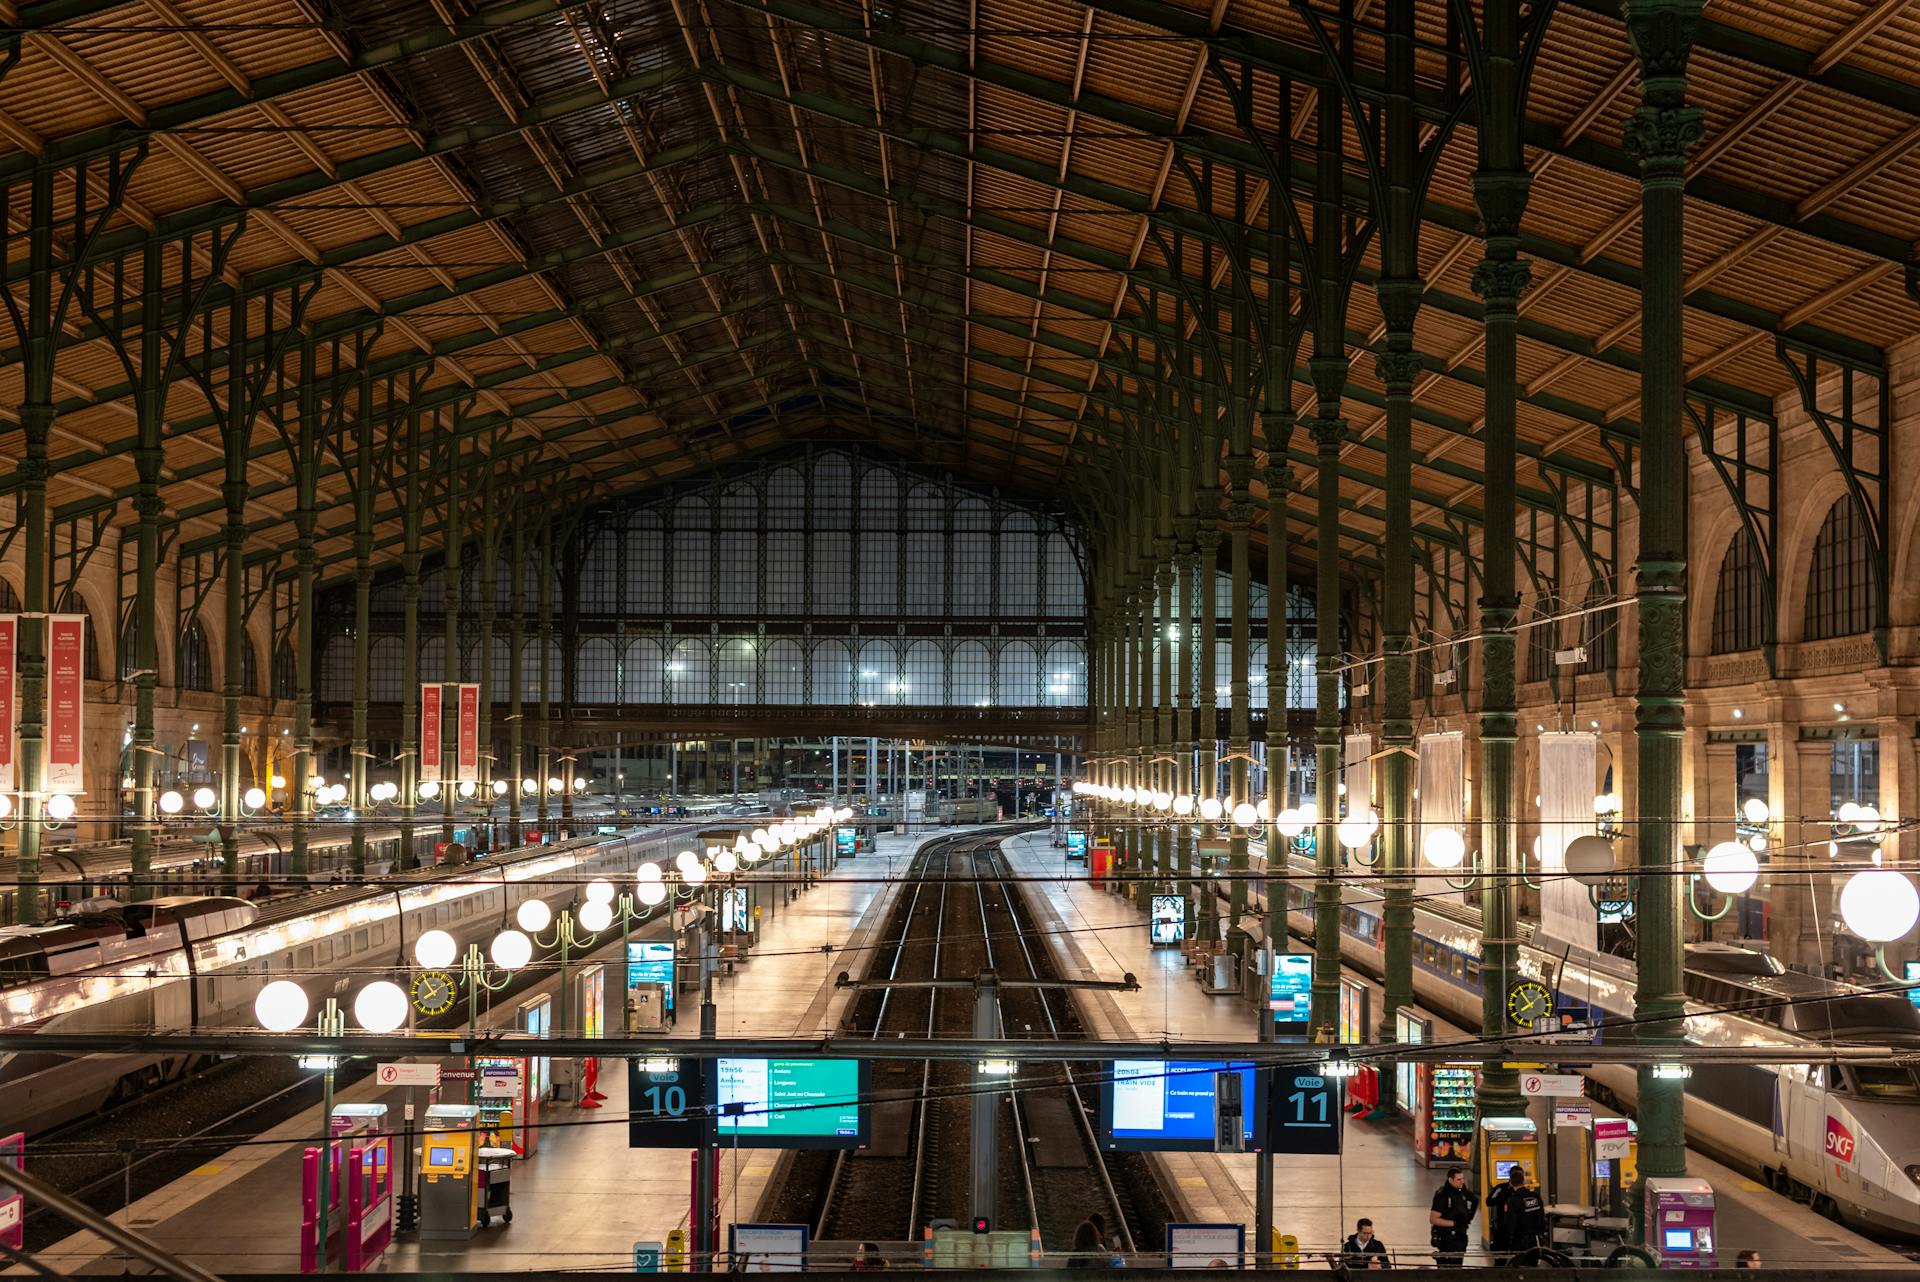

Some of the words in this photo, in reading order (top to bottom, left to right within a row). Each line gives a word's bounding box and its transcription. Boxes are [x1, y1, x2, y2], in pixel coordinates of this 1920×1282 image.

[440, 1070, 475, 1078] ienvenue
[653, 1073, 675, 1081] Voie
[1298, 1078, 1320, 1087] Voie
[643, 1086, 686, 1116] 10
[1288, 1092, 1327, 1121] 11
[1827, 1131, 1853, 1156] SNCF
